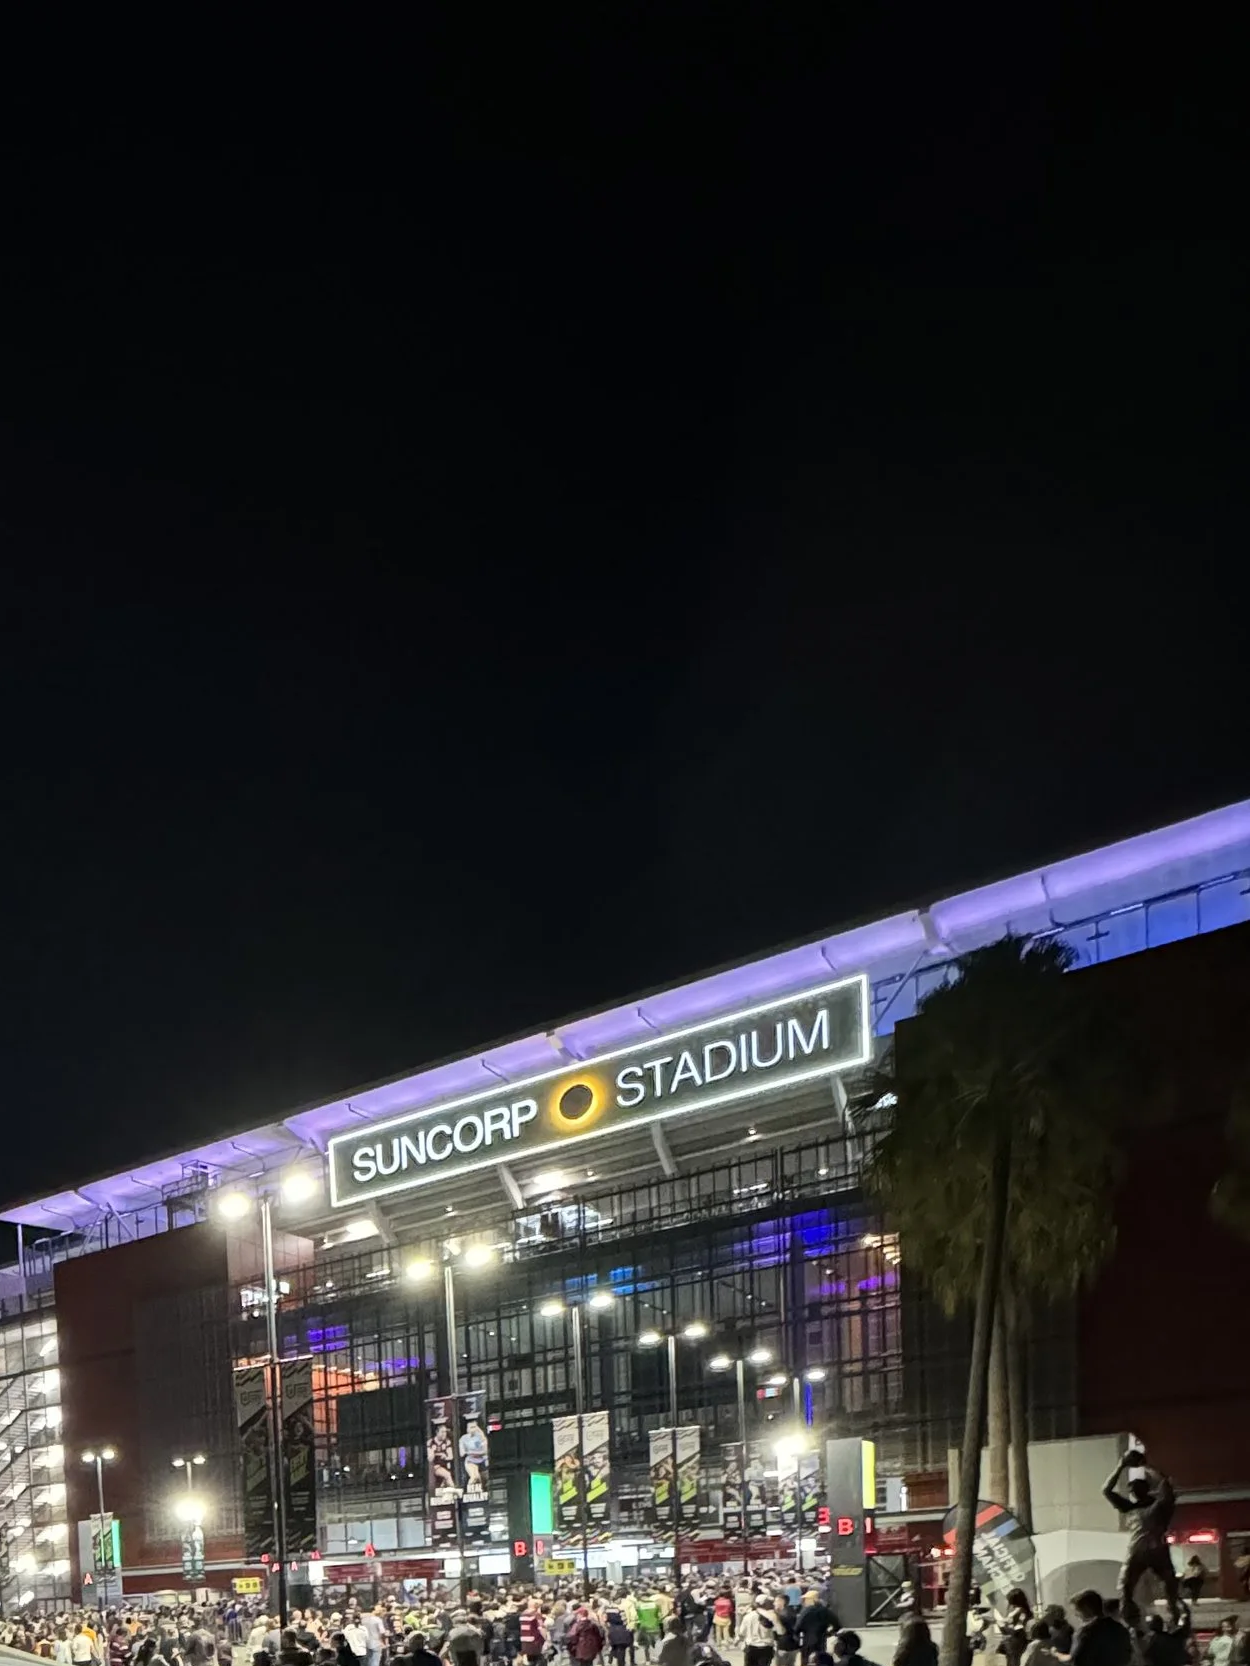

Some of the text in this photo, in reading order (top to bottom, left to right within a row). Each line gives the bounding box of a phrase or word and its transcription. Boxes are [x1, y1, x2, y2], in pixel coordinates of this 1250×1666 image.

[352, 1009, 830, 1182] SUNCORP STADIUM
[838, 1518, 854, 1536] B
[365, 1543, 375, 1558] A
[514, 1541, 527, 1556] B
[84, 1572, 93, 1585] A
